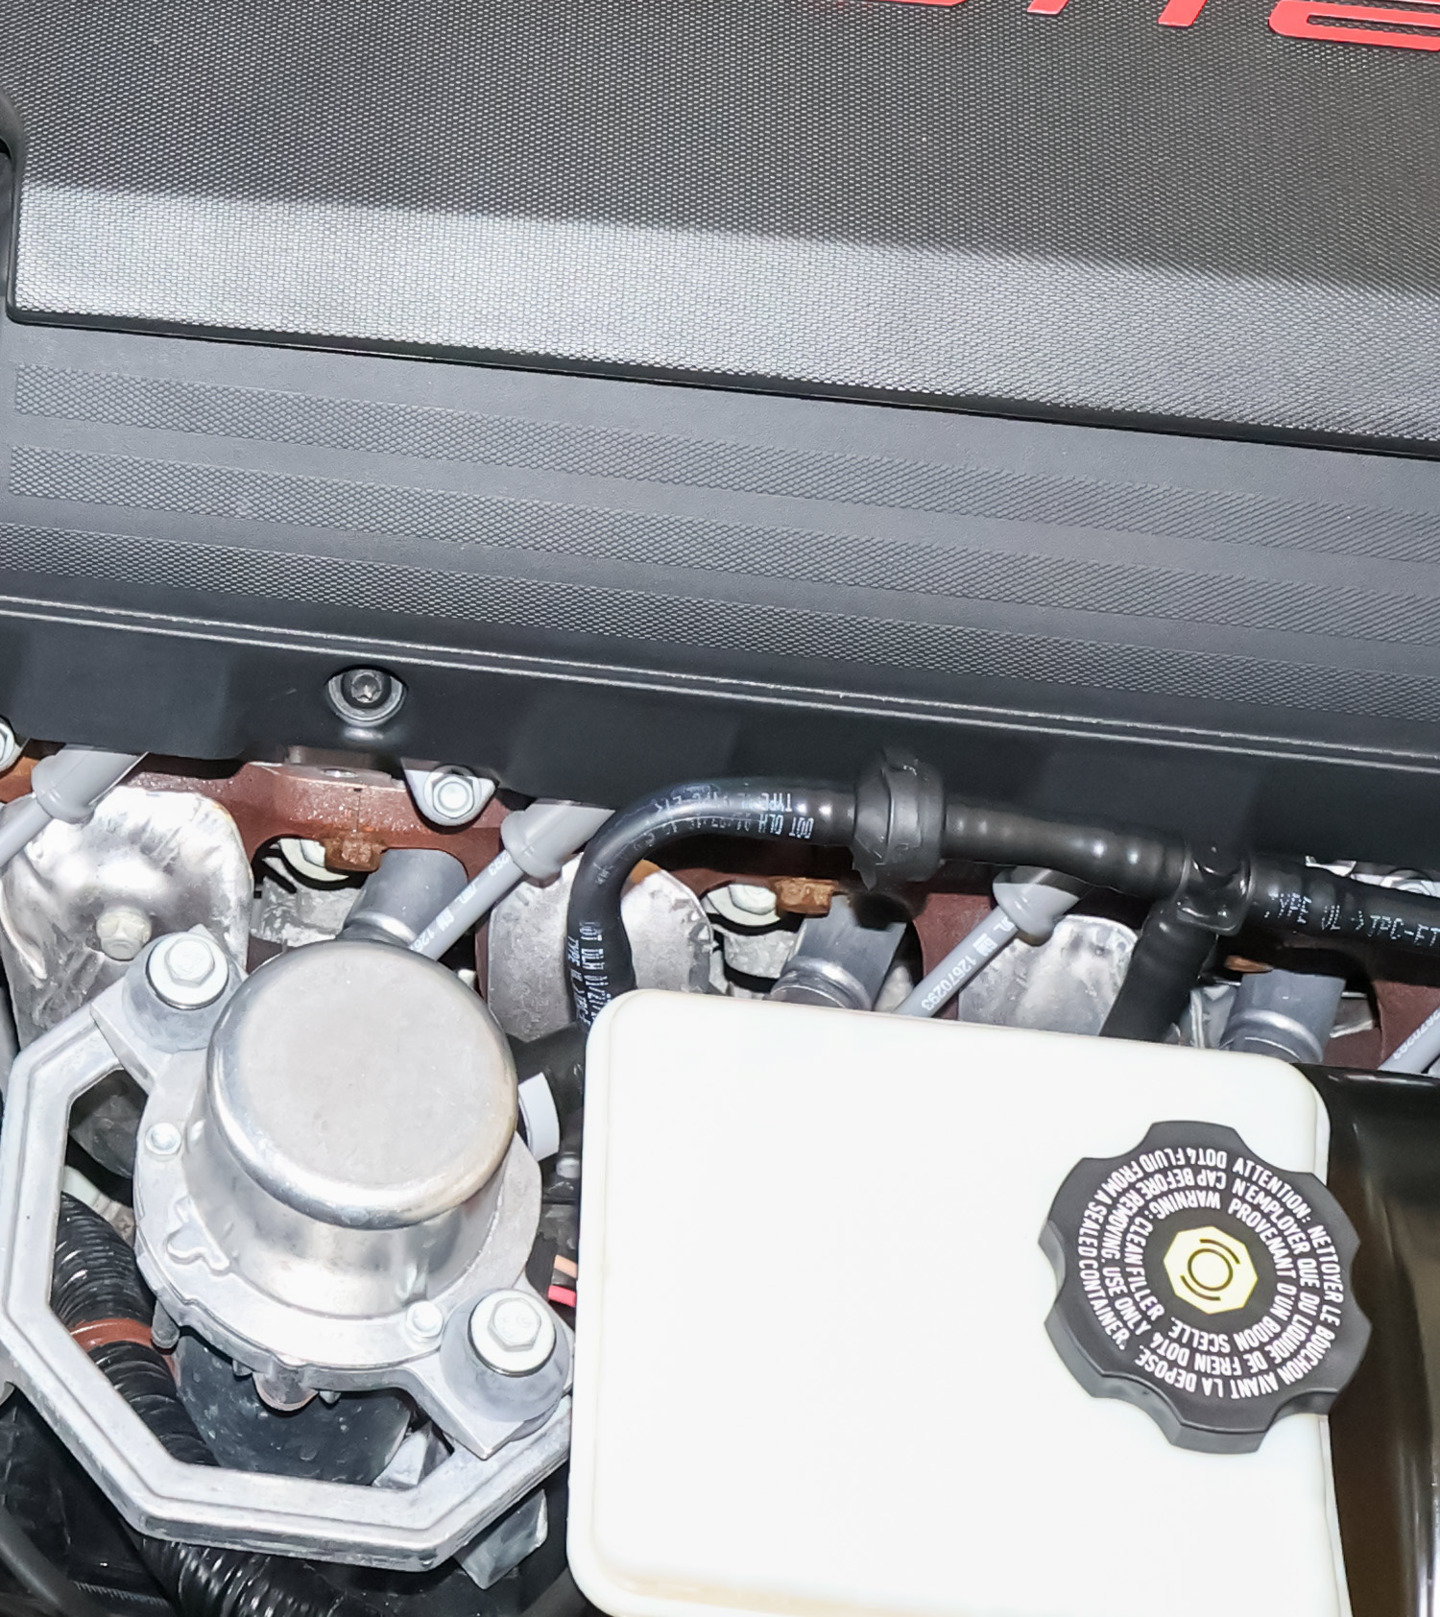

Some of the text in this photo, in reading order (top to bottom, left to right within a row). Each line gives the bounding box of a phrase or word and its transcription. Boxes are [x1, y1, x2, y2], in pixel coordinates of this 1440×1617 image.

[921, 954, 978, 1011] 12670293
[1077, 1147, 1228, 1350] DOT4 FLUID FROM A SEALED CONTAINER.
[1101, 1168, 1227, 1336] CAP BEFORE REMOVING. USE ONLY
[1124, 1216, 1154, 1266] CLEAN
[1227, 1198, 1297, 1279] PROVENANT
[1125, 1267, 1165, 1322] FILLER
[1135, 1157, 1344, 1400] ATTENTION: NETTOYER LE BOUCHON AVANT LA DEPOSE.
[1149, 1178, 1321, 1376] N'EMPLOYER QUE DU LIQUIDE DE FREIN DOT4
[1270, 1283, 1297, 1321] D'UN
[1233, 1315, 1282, 1352] BIDON
